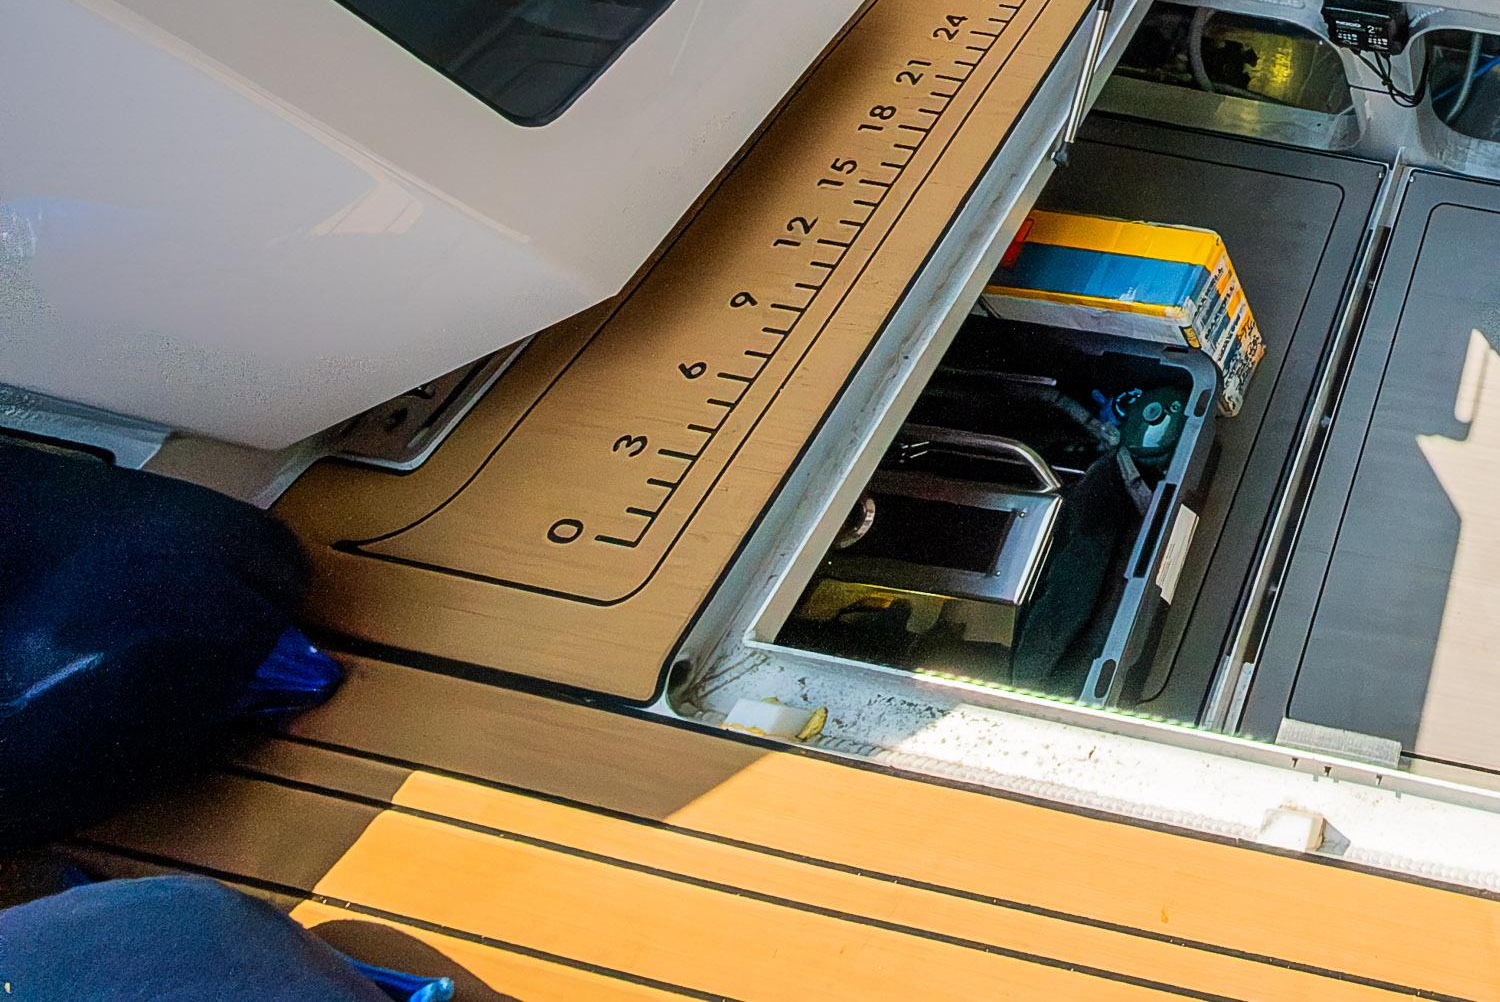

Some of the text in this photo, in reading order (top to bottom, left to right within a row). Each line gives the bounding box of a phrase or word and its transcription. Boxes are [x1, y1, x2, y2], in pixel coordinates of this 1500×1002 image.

[546, 518, 584, 544] 0
[612, 434, 648, 458] 3
[677, 361, 707, 380] 6
[729, 291, 758, 308] 9
[772, 216, 819, 247] 12
[816, 157, 858, 187] 15
[857, 104, 898, 132] 18
[895, 59, 932, 86] 21
[932, 14, 969, 41] 24
